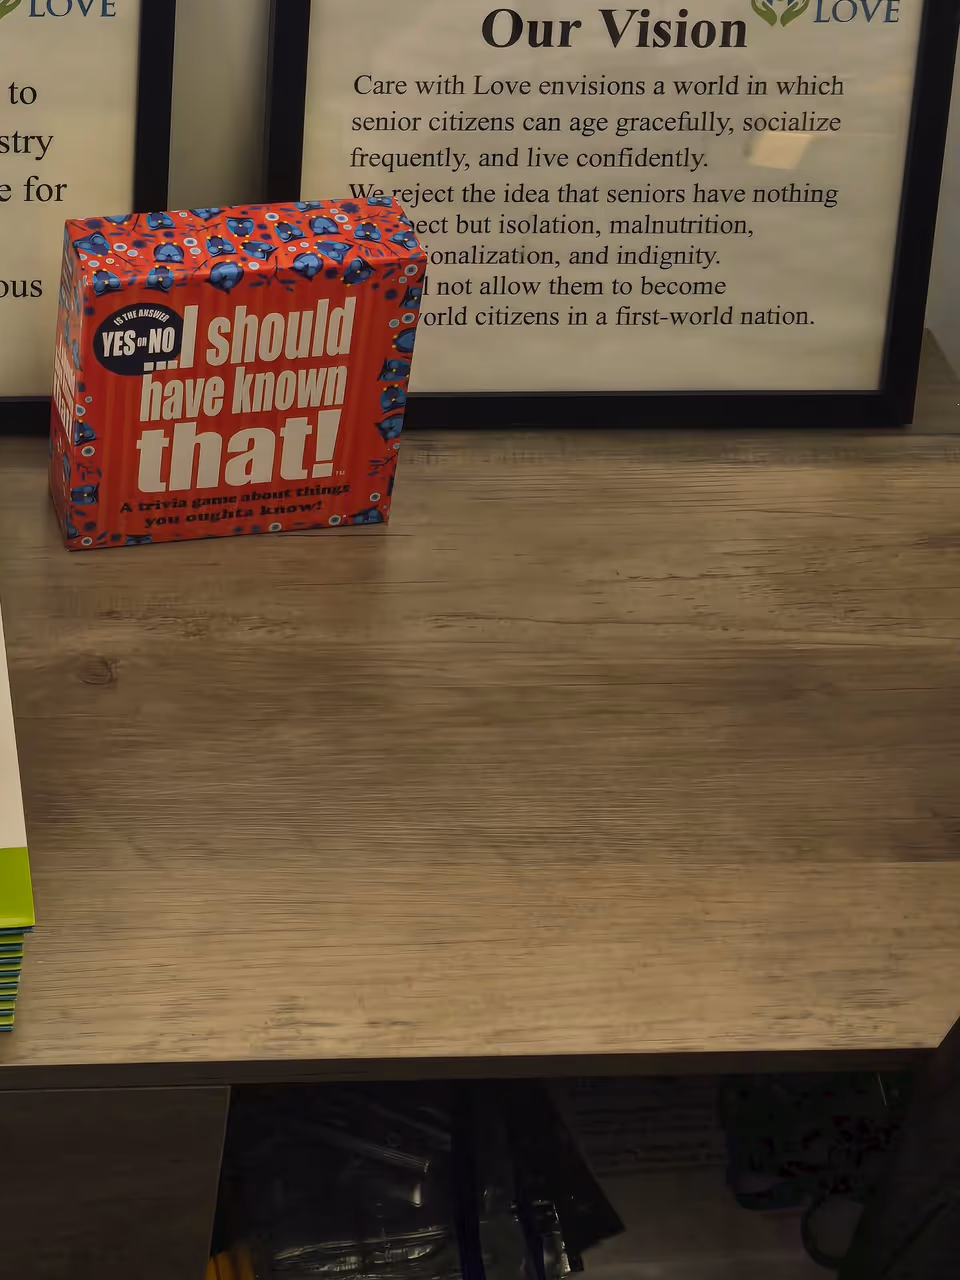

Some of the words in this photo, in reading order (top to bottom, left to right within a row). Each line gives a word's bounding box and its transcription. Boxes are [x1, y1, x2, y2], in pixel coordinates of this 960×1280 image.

[813, 0, 900, 23] LOVE
[482, 9, 582, 48] Our
[598, 9, 747, 48] Vision
[8, 82, 37, 105] to
[354, 75, 407, 95] Care
[414, 74, 466, 95] with
[472, 75, 531, 95] Love
[539, 75, 645, 95] envisions
[653, 81, 665, 95] a
[672, 75, 739, 95] world
[746, 75, 768, 95] in
[776, 75, 844, 95] which
[352, 111, 422, 131] senior
[429, 111, 514, 131] citizens
[523, 117, 561, 131] can
[570, 117, 608, 137] age
[615, 111, 734, 137] gracefully,
[743, 111, 841, 131] socialize
[350, 147, 470, 173] frequently,
[479, 147, 519, 167] and
[527, 146, 568, 167] live
[576, 147, 708, 172] confidently.
[23, 175, 67, 202] for
[349, 183, 384, 199] We
[392, 183, 455, 208] reject
[462, 183, 495, 203] the
[504, 183, 550, 203] idea
[557, 183, 600, 203] that
[607, 183, 685, 203] seniors
[692, 183, 746, 203] have
[752, 183, 839, 208] nothing
[456, 214, 491, 234] but
[499, 214, 601, 238] isolation,
[608, 214, 753, 237] malnutrition,
[568, 245, 608, 264] and
[616, 245, 720, 270] indignity.
[436, 279, 472, 295] not
[480, 276, 541, 295] allow
[548, 276, 603, 295] them
[612, 279, 632, 295] to
[641, 276, 726, 295] become
[113, 317, 124, 326] IS
[122, 310, 138, 321] THE
[138, 309, 170, 323] ANSWER
[475, 306, 559, 325] citizens
[567, 306, 588, 325] in
[596, 312, 608, 325] a
[615, 306, 733, 327] first-world
[740, 305, 814, 325] nation.
[102, 329, 136, 357] YES
[148, 326, 176, 354] NO
[206, 296, 357, 367] should
[139, 373, 225, 422] have
[231, 365, 348, 415] known
[136, 408, 342, 493] that!
[120, 502, 133, 513] A
[138, 497, 187, 512] trivia
[191, 493, 238, 509] game
[241, 488, 291, 503] about
[296, 483, 351, 498] things
[144, 516, 180, 528] you
[185, 508, 253, 524] oughta
[260, 501, 323, 516] know!
